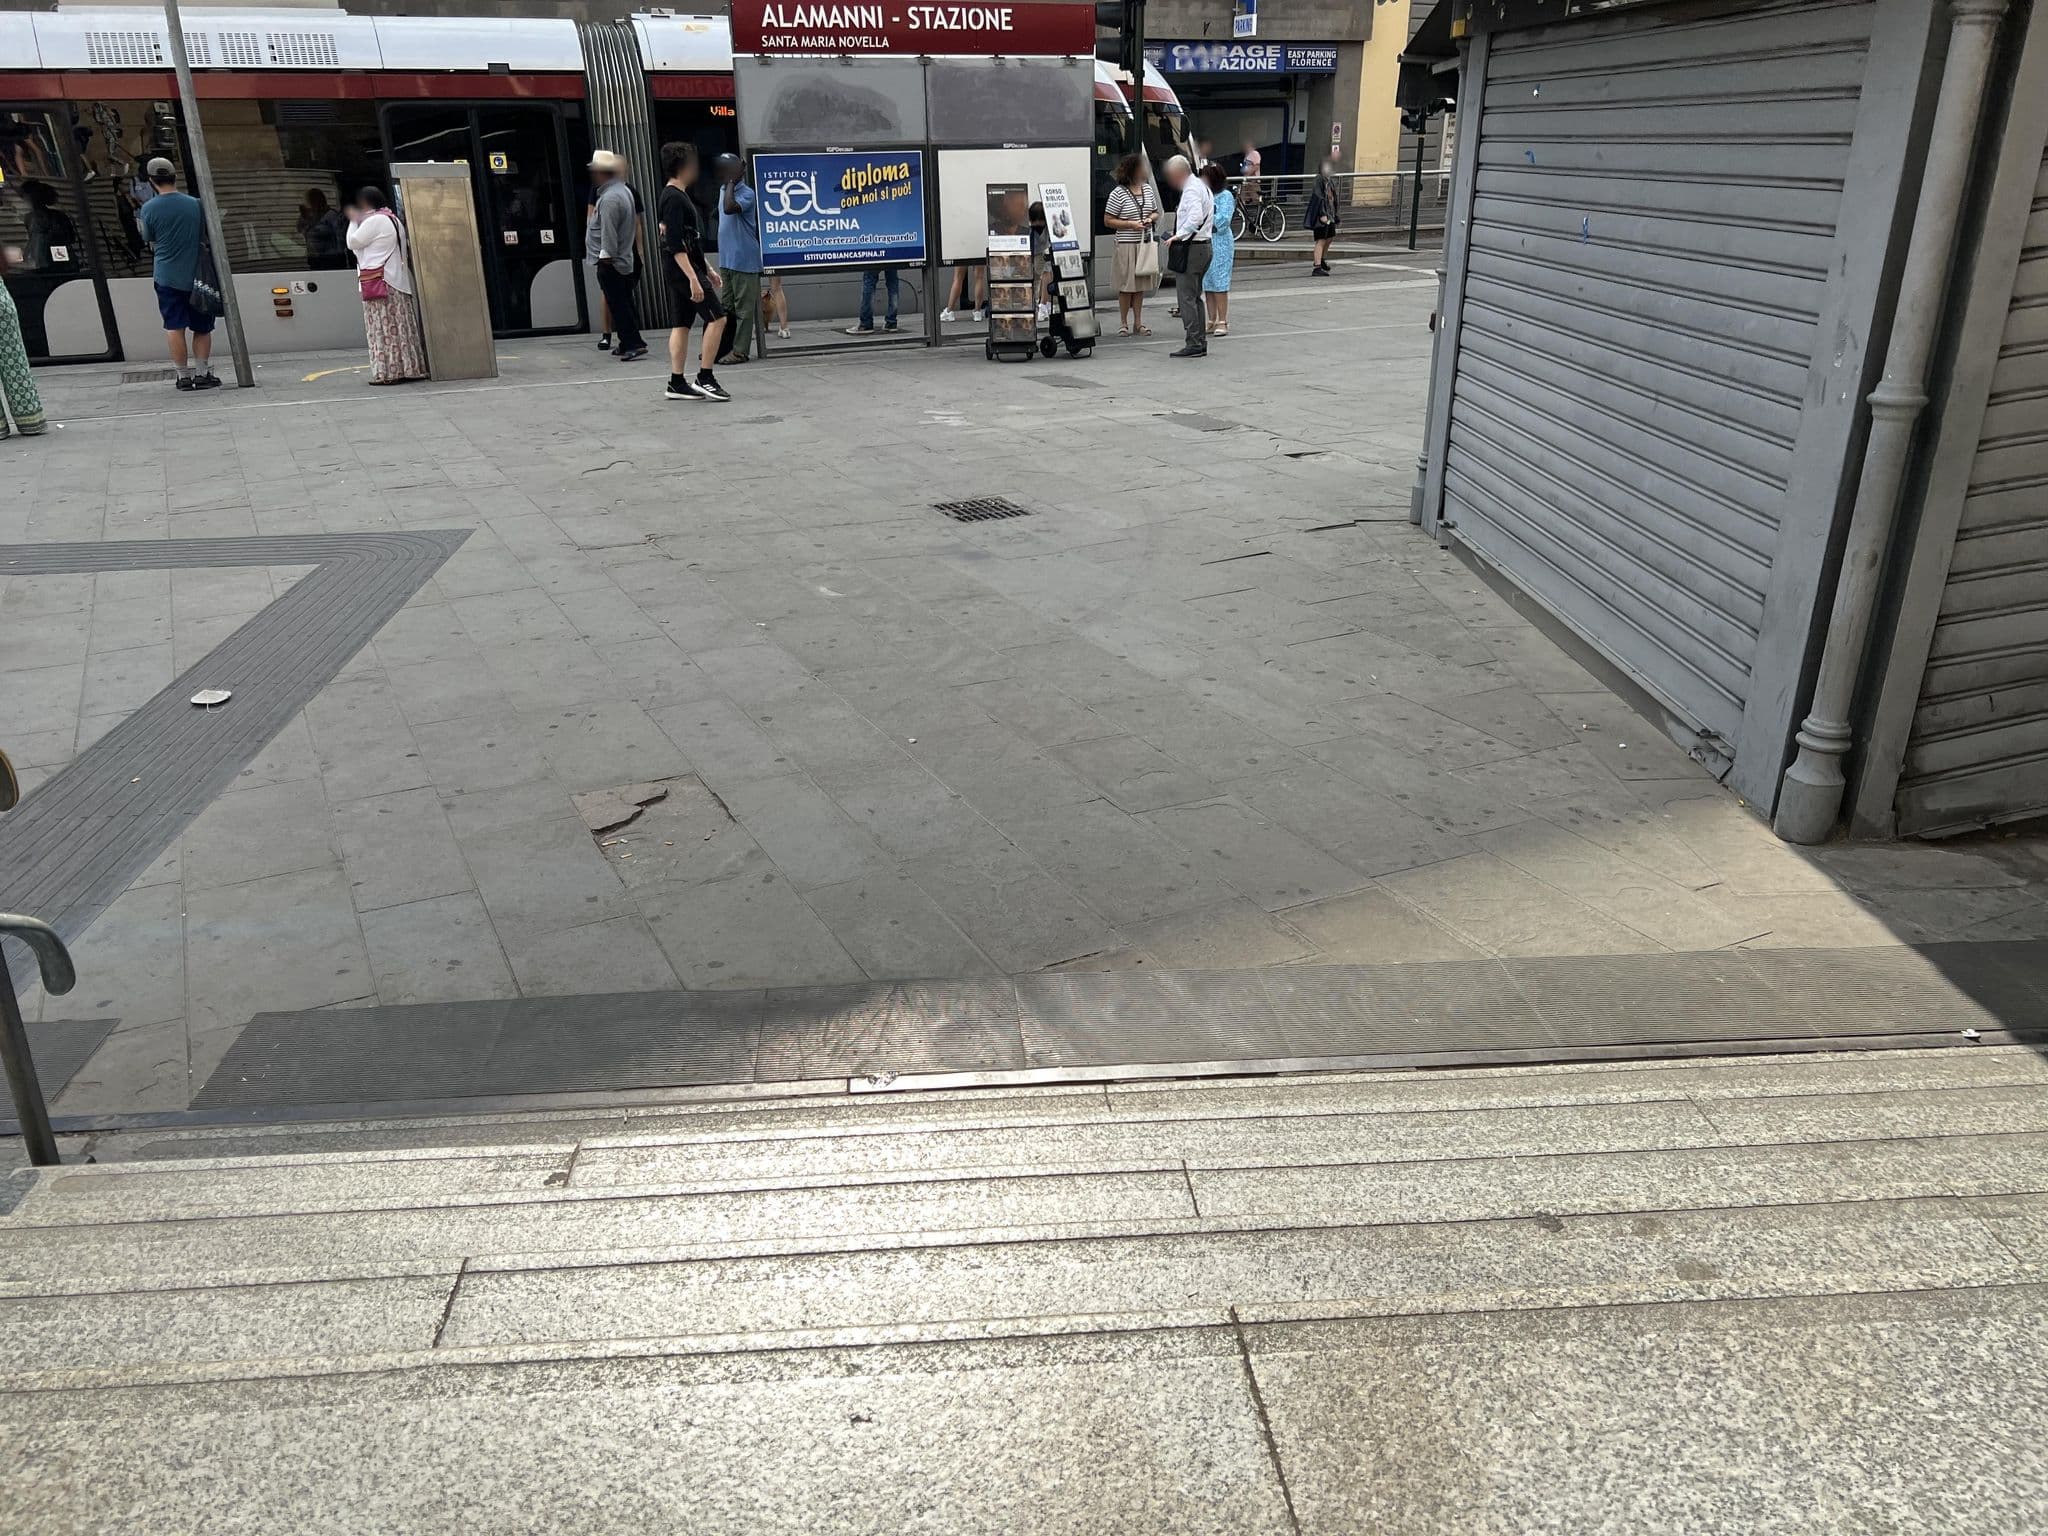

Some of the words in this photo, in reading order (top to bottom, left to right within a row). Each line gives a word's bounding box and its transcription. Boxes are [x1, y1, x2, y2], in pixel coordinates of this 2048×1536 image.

[761, 4, 884, 29] ALAMANNI
[907, 6, 1013, 31] STAZIONE
[761, 35, 798, 48] SANTA
[801, 35, 836, 48] MARIA
[839, 36, 890, 48] NOVELLA
[1288, 50, 1306, 59] EASY
[1307, 50, 1337, 59] PARKING
[1291, 58, 1333, 67] FLORENCE
[710, 105, 735, 116] Villa
[764, 171, 807, 179] ISTITUTO
[841, 162, 910, 193] diploma
[841, 195, 860, 209] con
[862, 188, 878, 205] noi
[880, 186, 889, 200] si
[892, 181, 912, 201] può!
[765, 218, 860, 234] BIANCASPINA
[813, 237, 823, 247] la
[823, 236, 858, 246] certezza
[859, 234, 873, 244] del
[804, 250, 886, 261] ISTITUTOBIANCASPINA.IT
